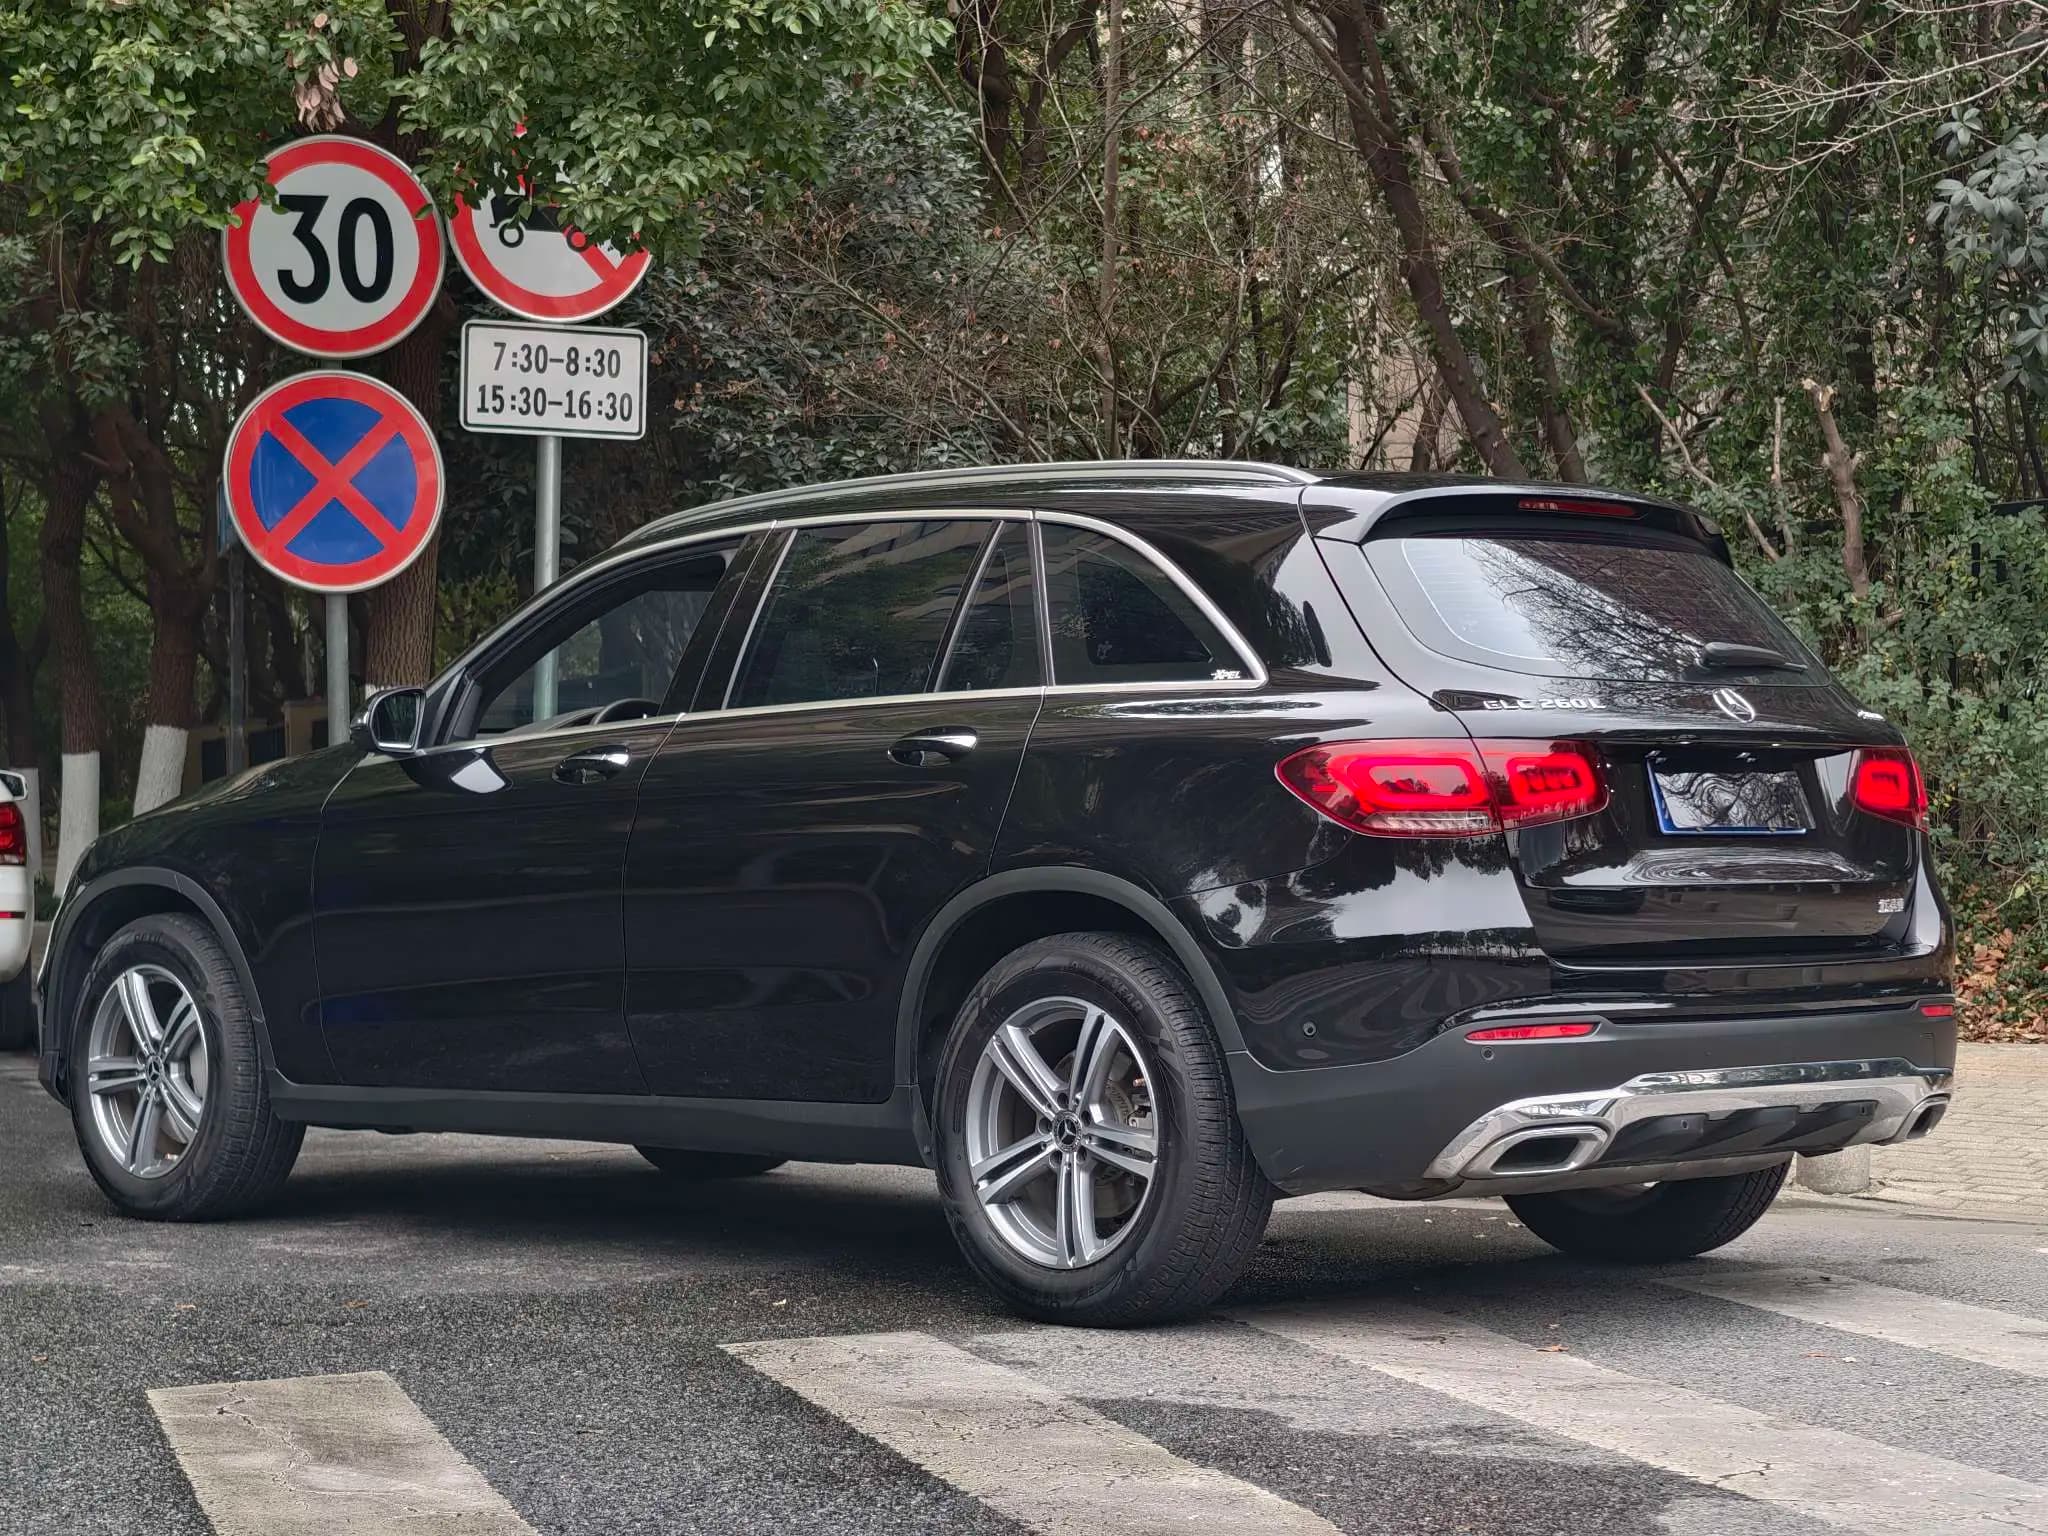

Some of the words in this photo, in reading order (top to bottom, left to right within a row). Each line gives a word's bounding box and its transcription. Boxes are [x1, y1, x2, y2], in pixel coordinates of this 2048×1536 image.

[277, 194, 394, 304] 30
[493, 341, 622, 379] 7:30-8:30
[476, 383, 633, 422] 15:30-16:30
[1211, 669, 1241, 680] XPEL
